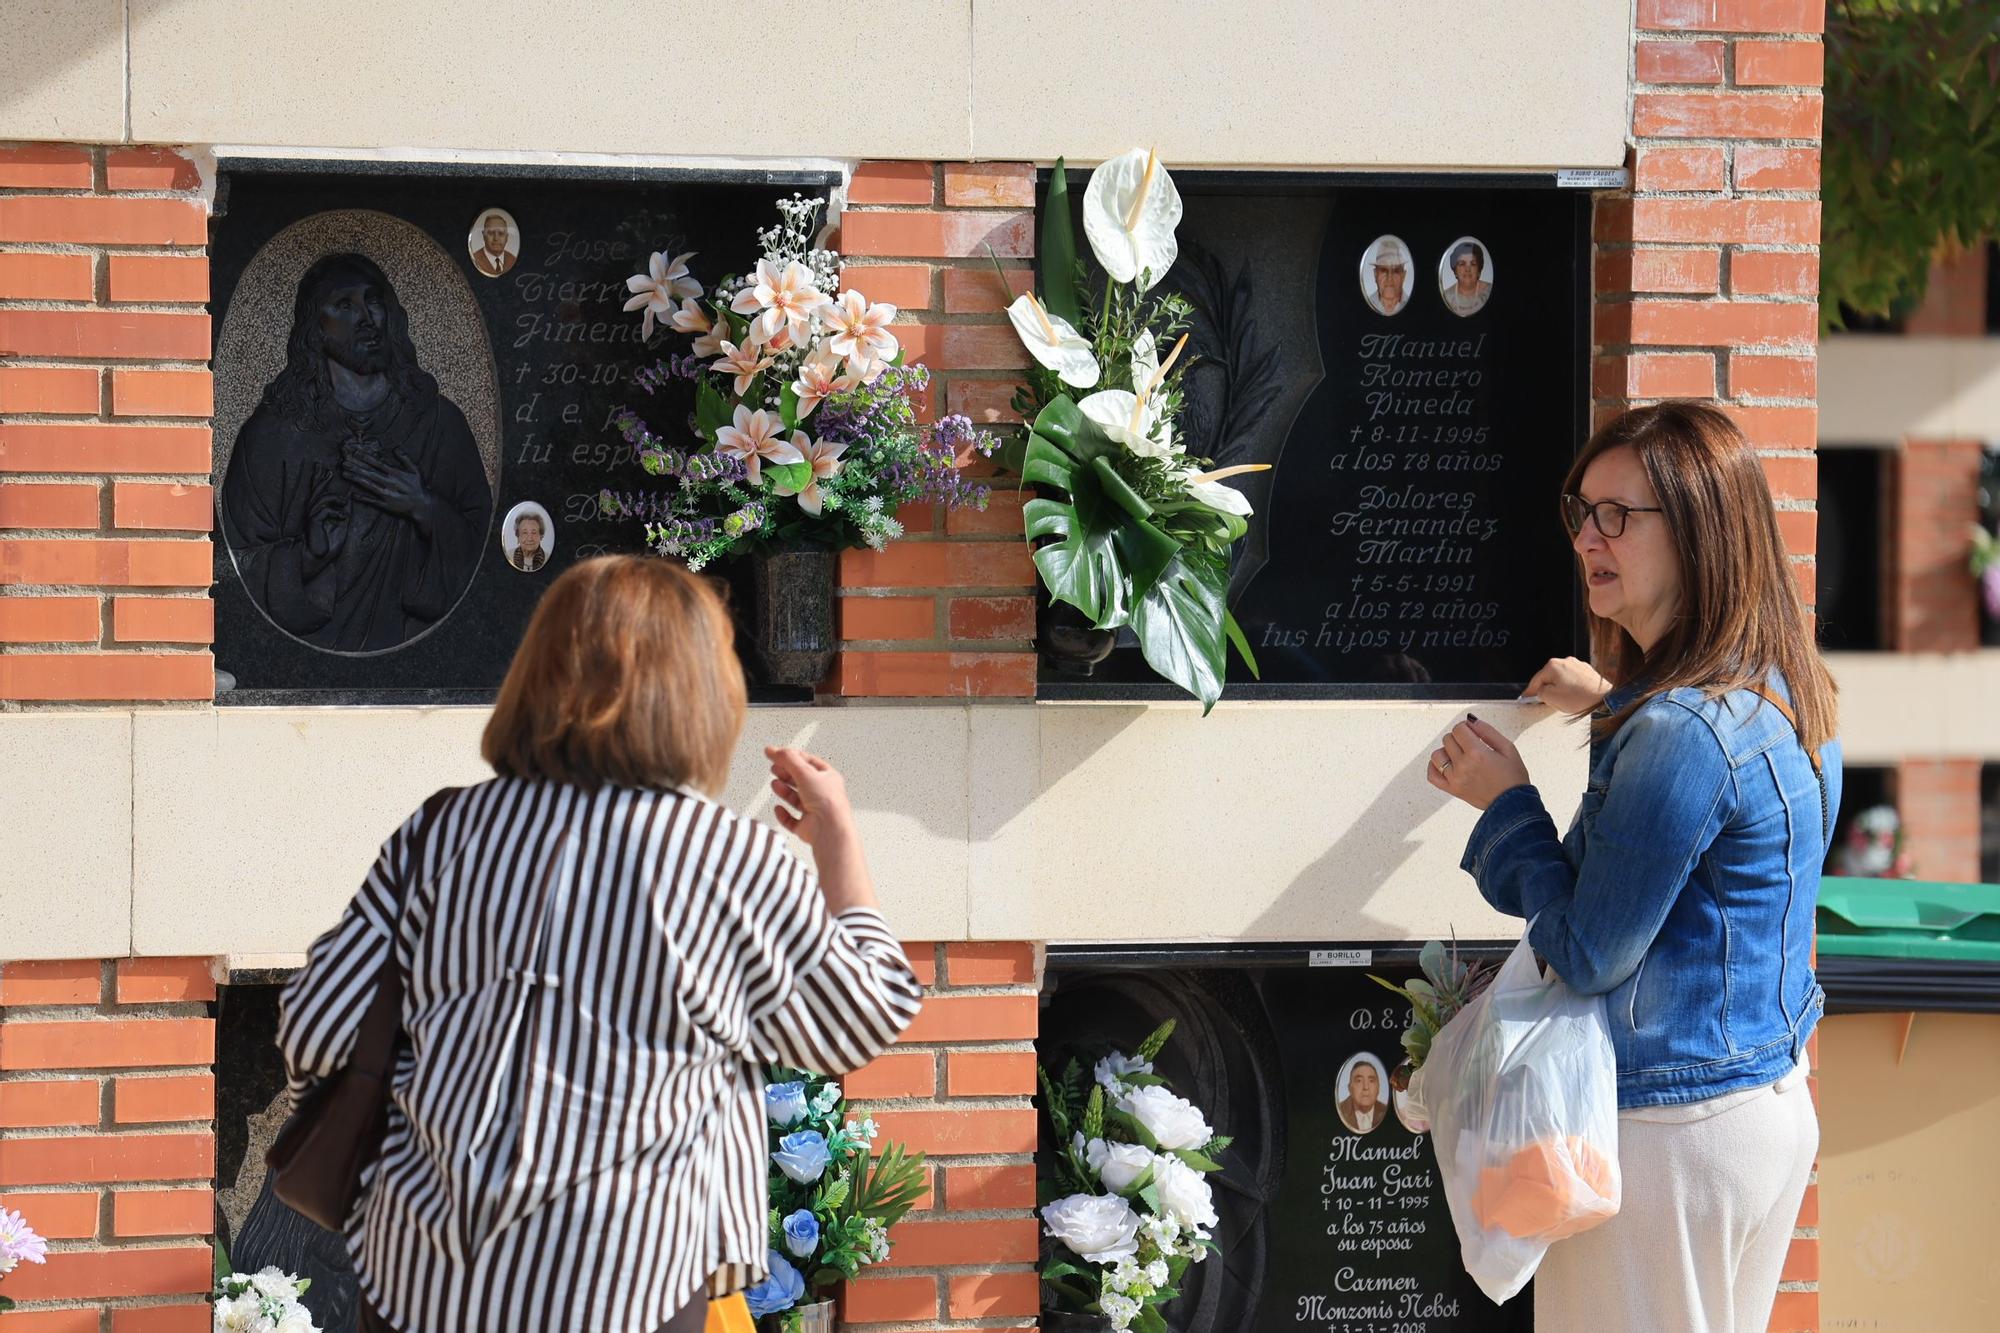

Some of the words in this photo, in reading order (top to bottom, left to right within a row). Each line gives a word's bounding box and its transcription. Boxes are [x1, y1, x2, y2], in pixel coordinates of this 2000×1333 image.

[1357, 333, 1488, 359] Manuel
[1359, 363, 1483, 387] Romero
[1365, 390, 1475, 422] Pineda
[517, 433, 551, 465] tu
[1330, 452, 1349, 471] a
[1352, 445, 1396, 471] los
[1403, 453, 1430, 471] 78
[1436, 450, 1505, 471] años
[1358, 484, 1477, 510] Dolores
[1330, 507, 1500, 541] Fernandez
[1356, 538, 1474, 564] Martin
[1325, 601, 1343, 619] a
[1348, 594, 1391, 619] los
[1398, 602, 1425, 619] 72
[1431, 599, 1500, 619] años
[1261, 622, 1308, 648] tus
[1314, 622, 1391, 654] hijos
[1399, 631, 1417, 649] y
[1422, 622, 1511, 649] nietos
[1327, 951, 1361, 959] BORILLO
[1329, 1135, 1424, 1162] Manuel
[1320, 1164, 1377, 1195] Juan
[1382, 1163, 1433, 1197] Gari
[1327, 1223, 1340, 1235] a
[1342, 1213, 1365, 1235] los
[1369, 1220, 1383, 1235] 75
[1387, 1217, 1426, 1234] años
[1337, 1239, 1358, 1251] su
[1361, 1237, 1414, 1259] esposa
[1334, 1266, 1419, 1292] Carmen
[1295, 1294, 1393, 1321] Monzonis
[1397, 1292, 1460, 1319] Nebot
